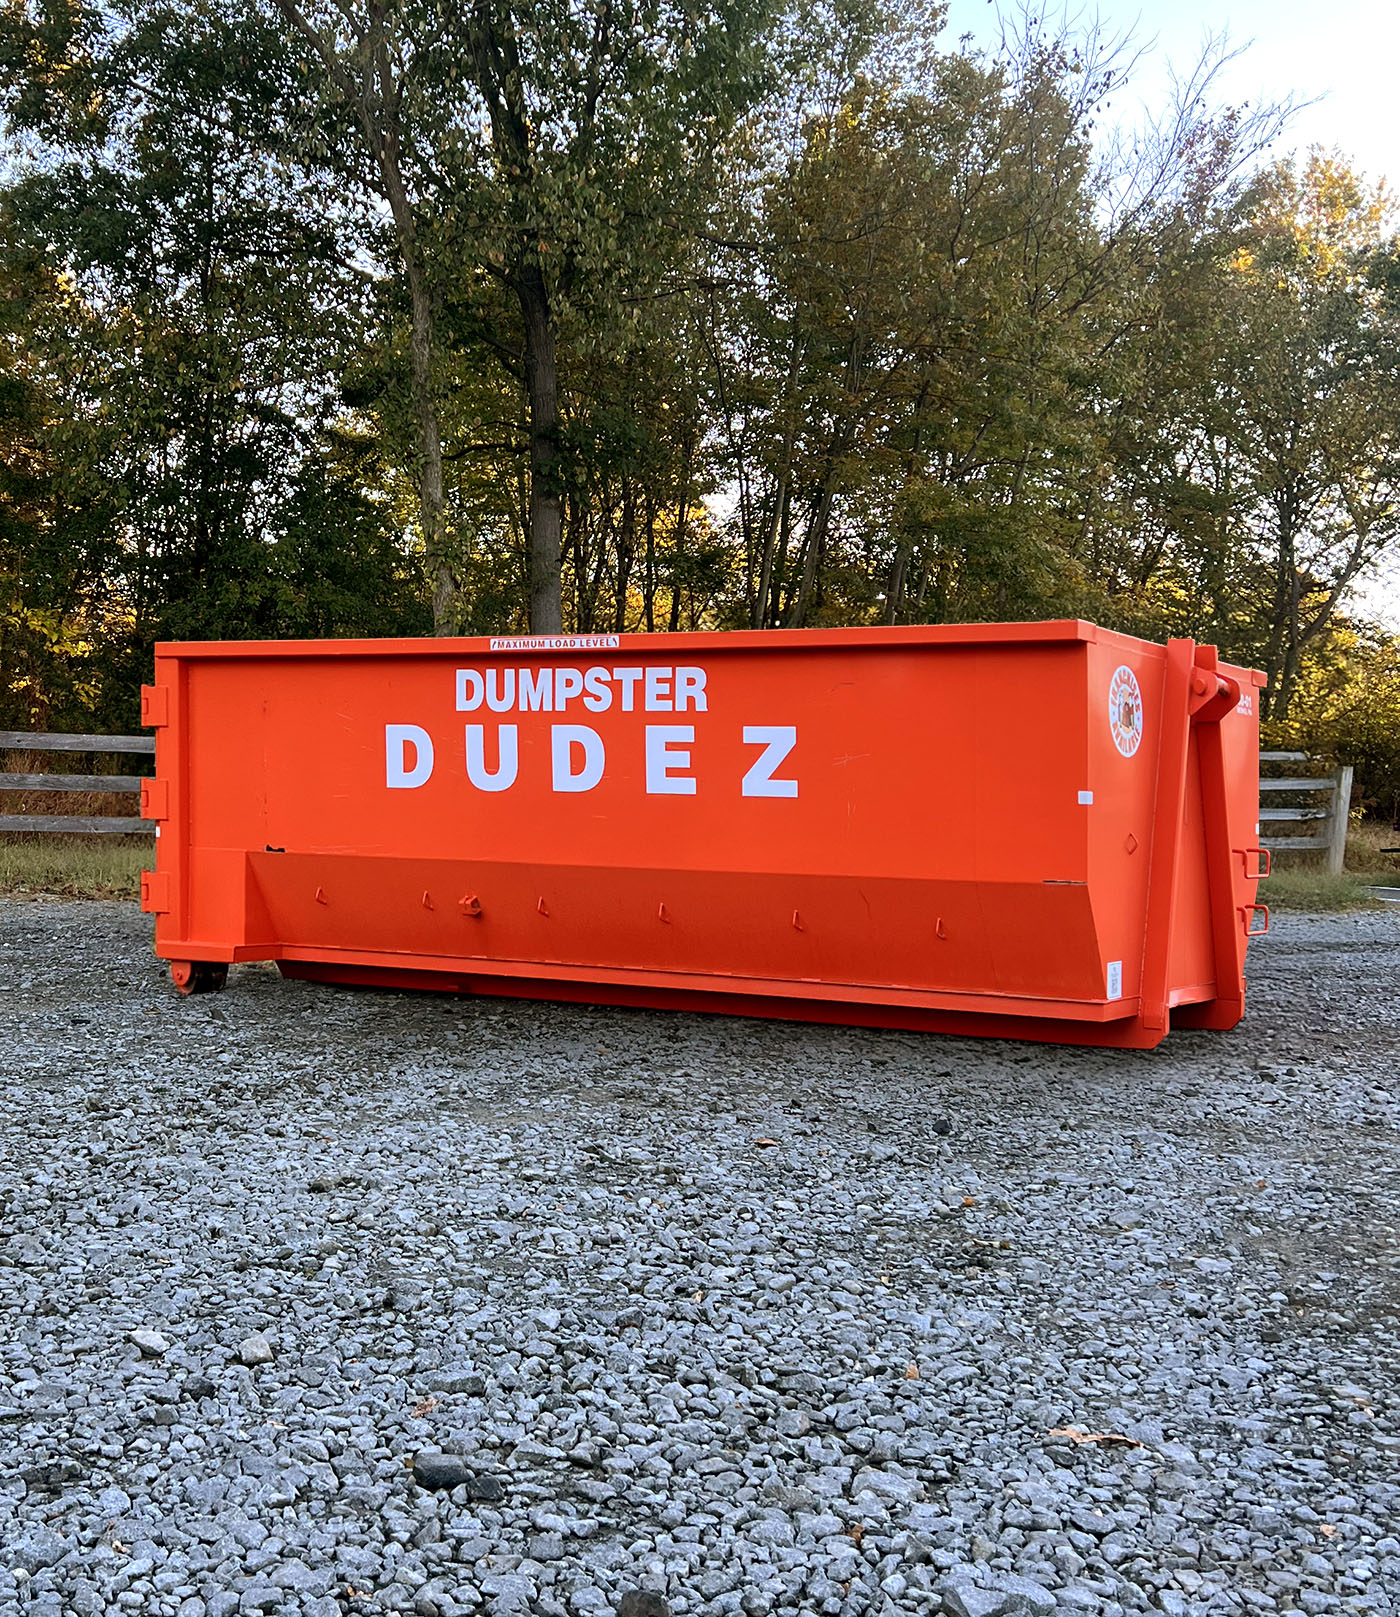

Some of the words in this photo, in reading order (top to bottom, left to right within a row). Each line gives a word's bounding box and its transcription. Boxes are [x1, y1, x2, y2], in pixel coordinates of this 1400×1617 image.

[497, 640, 545, 649] MAXIMUM
[549, 639, 576, 648] LOAD
[580, 638, 611, 647] LEVEL
[456, 667, 708, 712] DUMPSTER
[386, 725, 798, 797] DUDEZ
